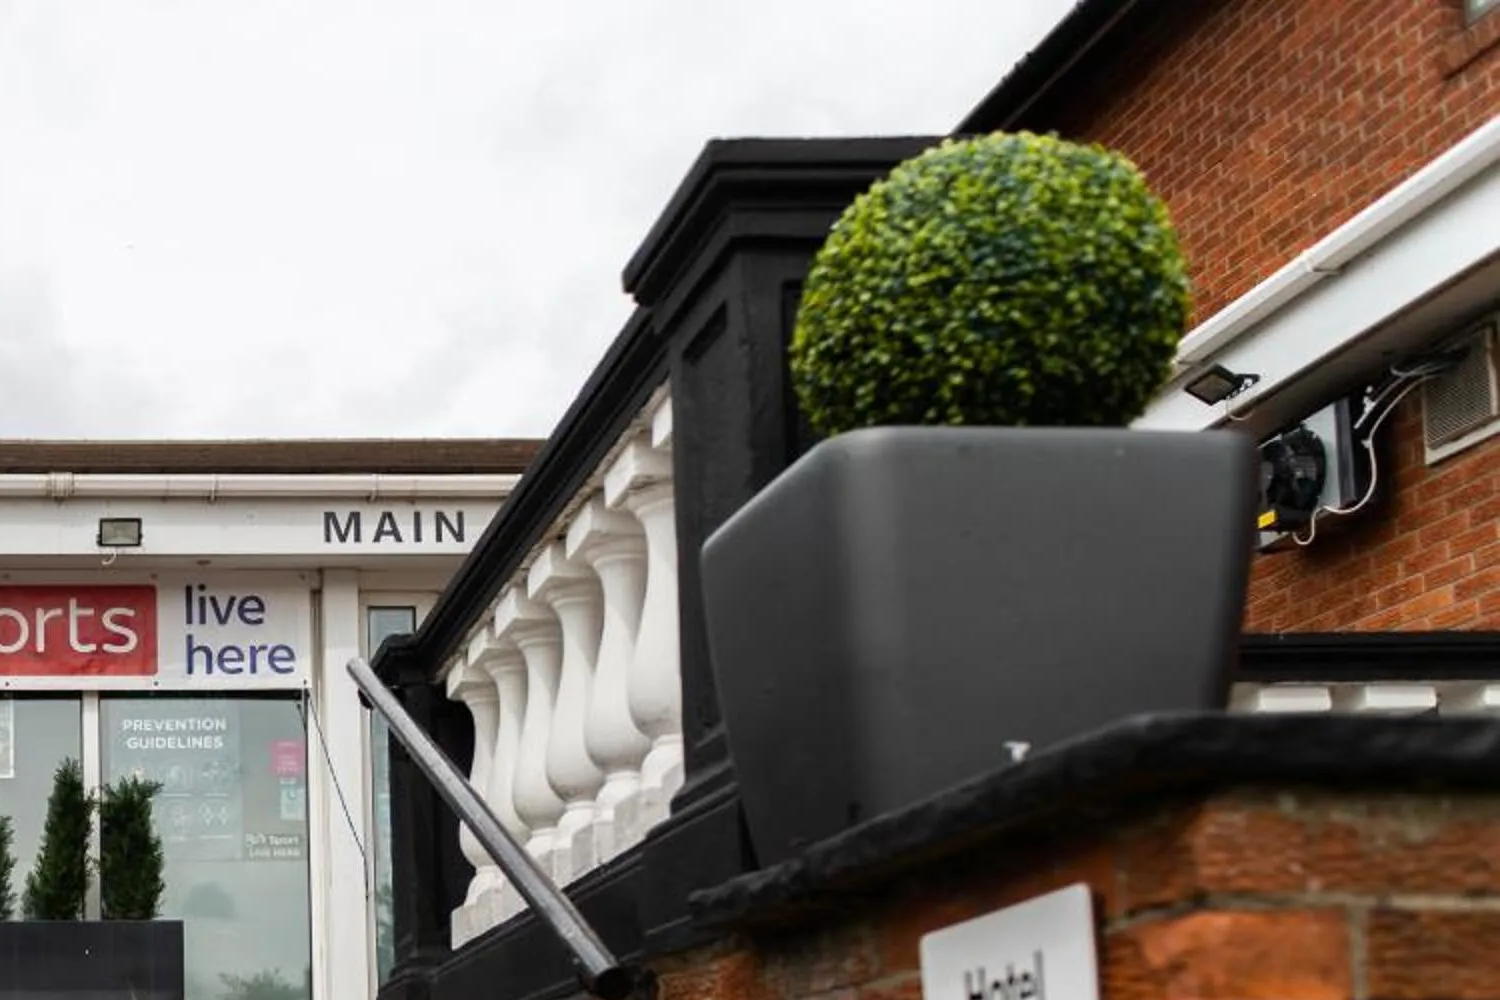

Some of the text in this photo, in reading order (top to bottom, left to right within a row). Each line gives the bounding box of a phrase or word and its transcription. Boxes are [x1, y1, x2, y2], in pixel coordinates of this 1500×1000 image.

[323, 510, 465, 543] MAIN
[184, 584, 266, 626] live
[185, 635, 296, 675] here
[122, 717, 227, 732] PREVENTION
[126, 736, 224, 750] GUIDELINES
